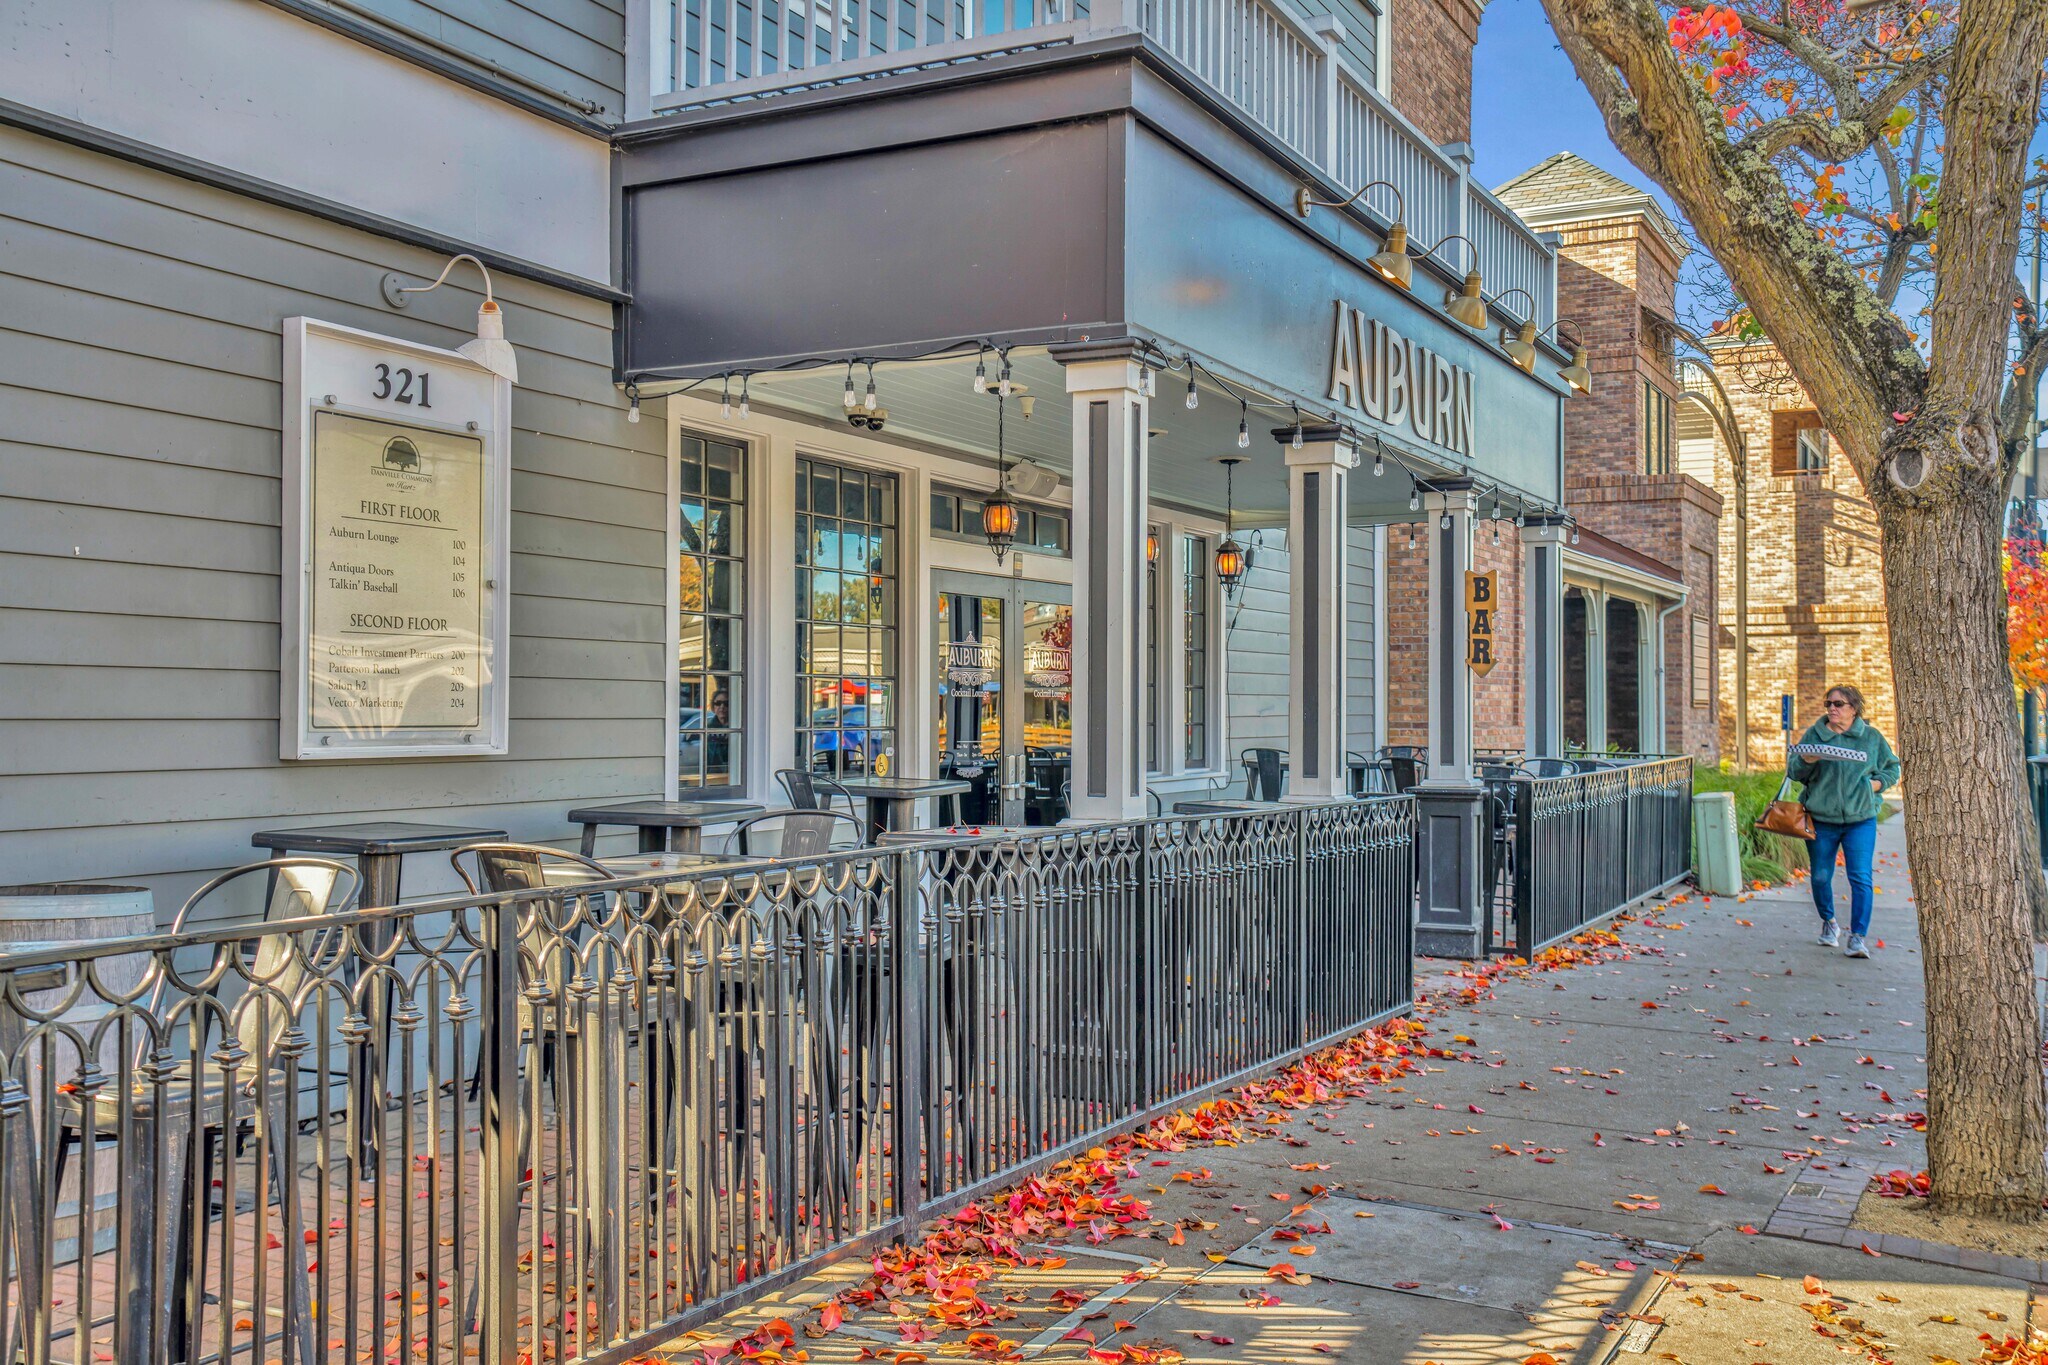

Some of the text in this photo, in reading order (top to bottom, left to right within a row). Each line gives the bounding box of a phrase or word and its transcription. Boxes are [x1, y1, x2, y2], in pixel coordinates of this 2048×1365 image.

[372, 363, 432, 408] 321
[1328, 299, 1476, 458] AUBURN
[370, 468, 433, 484] DANVILLE COMMONS
[360, 500, 442, 523] FIRST FLOOR
[329, 526, 466, 550] Auburn Lounge 100
[452, 556, 466, 566] 104
[329, 561, 465, 582] Antiqua Doors 105
[363, 581, 398, 593] Baseball
[452, 588, 466, 598] 106
[350, 613, 448, 632] SECOND FLOOR
[1471, 576, 1491, 665] BAR
[328, 645, 466, 660] Cobalt Investment Partners 200
[948, 646, 992, 668] AUBURN
[1031, 651, 1069, 670] AUBURN
[328, 662, 465, 676] Patterson Ranch 202
[328, 680, 465, 692] Salon h2 203
[951, 688, 990, 701] Cocktail Lounge
[328, 696, 465, 709] Vector Marketing 204
